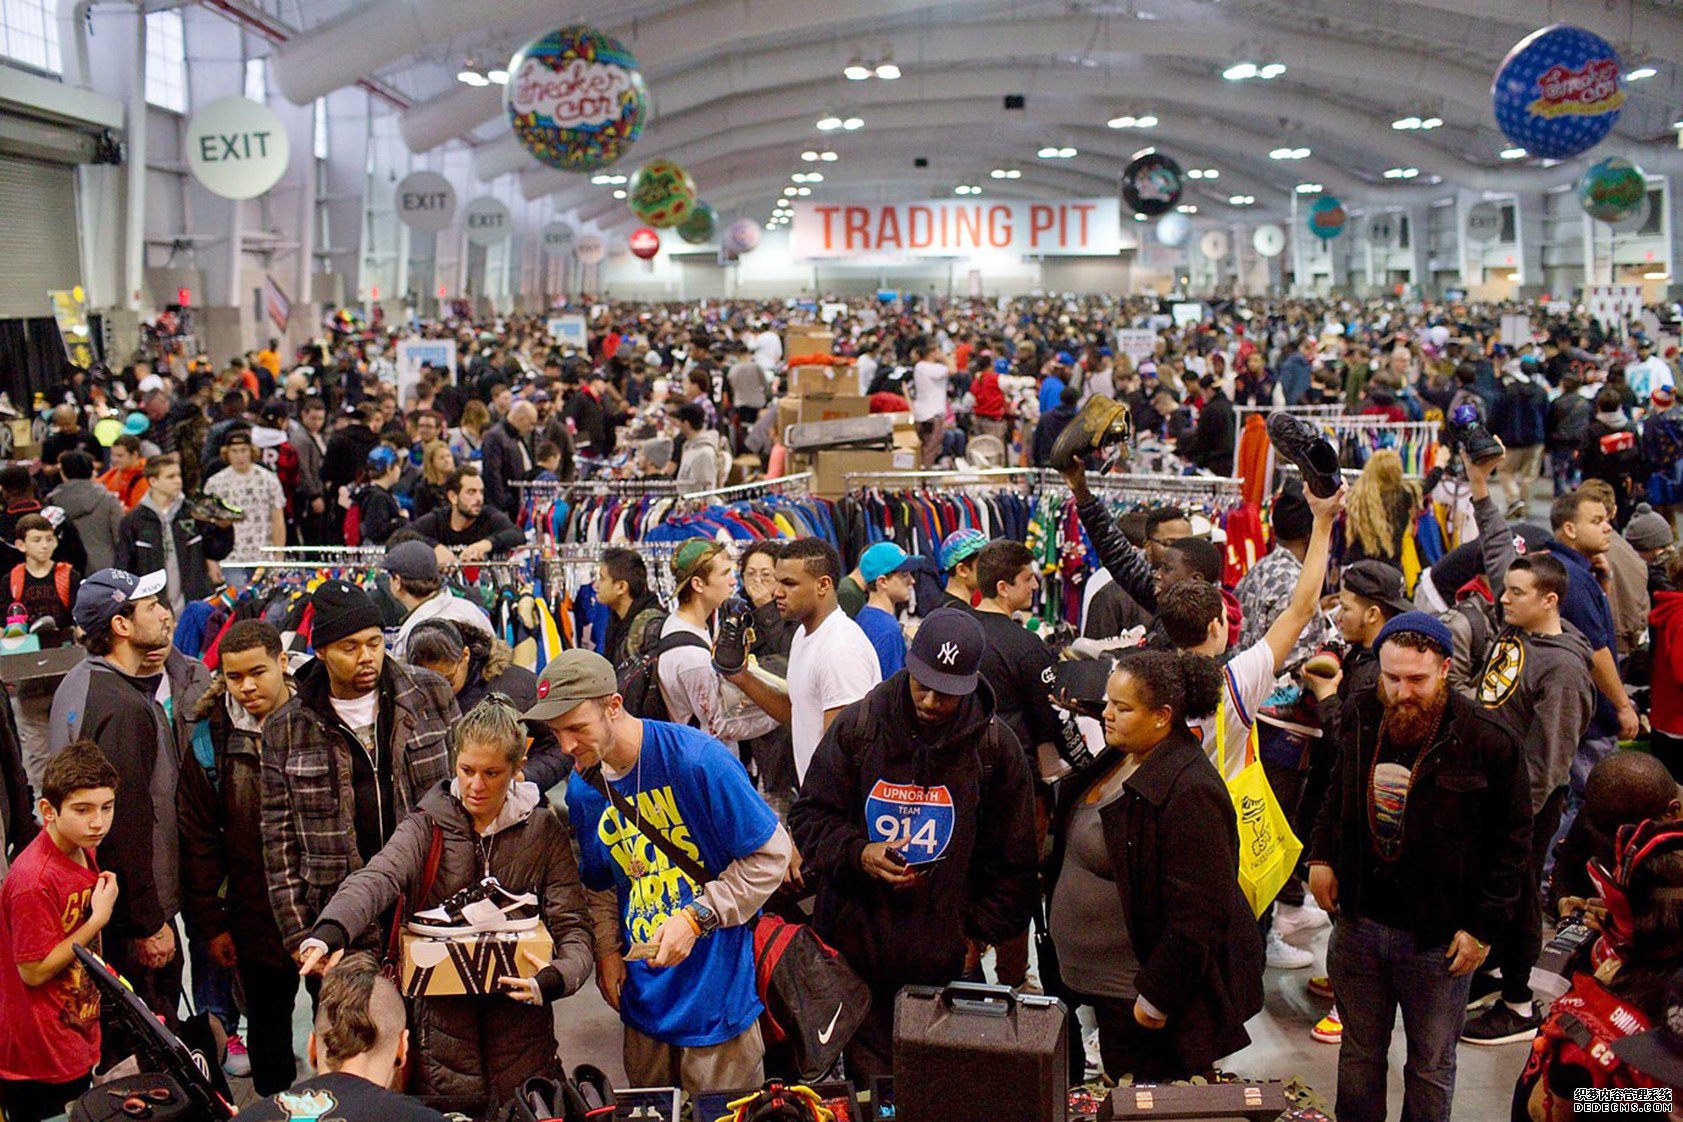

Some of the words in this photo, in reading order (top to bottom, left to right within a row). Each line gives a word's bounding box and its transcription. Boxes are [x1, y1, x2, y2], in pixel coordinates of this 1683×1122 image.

[200, 132, 271, 162] EXIT
[402, 193, 447, 211] EXIT
[468, 212, 504, 229] EXIT
[814, 204, 1013, 249] TRADING
[1029, 204, 1097, 247] PIT
[899, 805, 921, 815] TEAM
[875, 814, 938, 855] 914
[1609, 1005, 1646, 1036] WING
